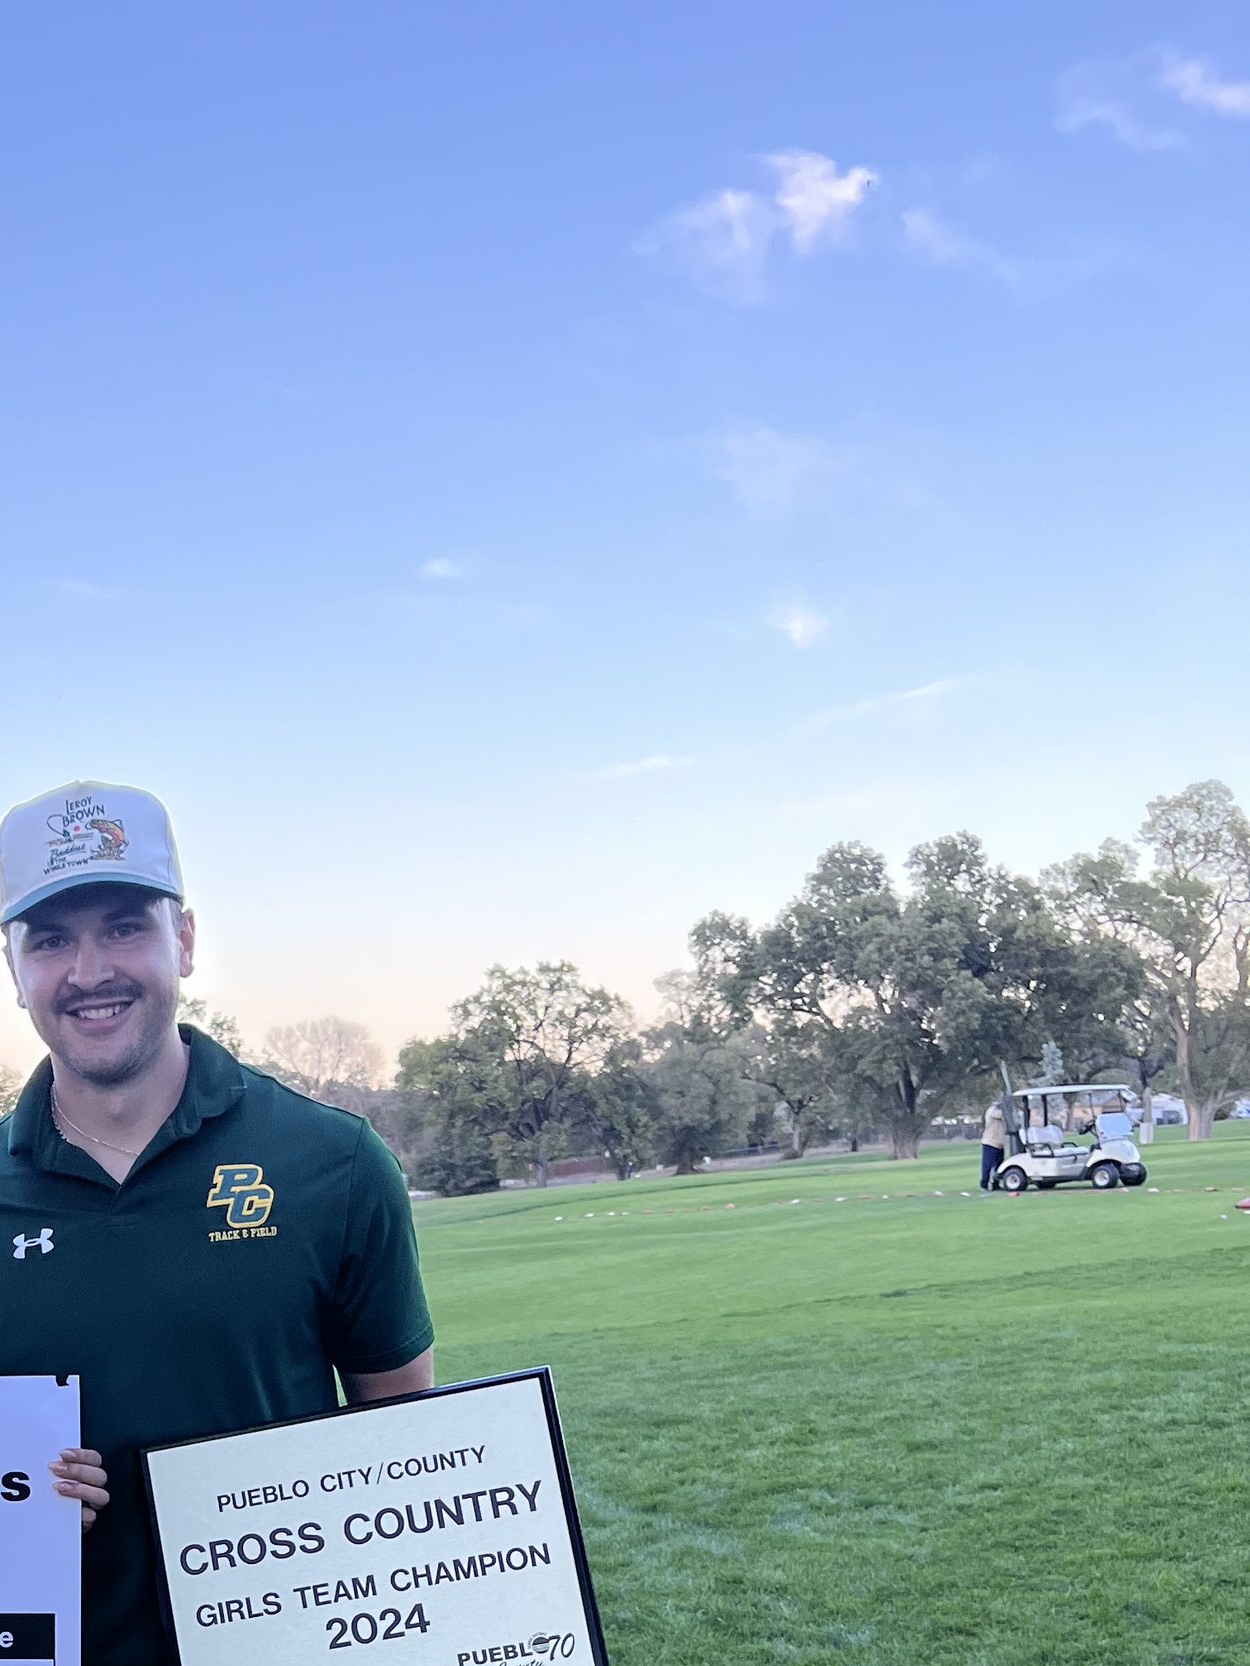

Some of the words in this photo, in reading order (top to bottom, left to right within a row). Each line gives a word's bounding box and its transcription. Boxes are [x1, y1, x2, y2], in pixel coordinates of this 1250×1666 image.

[63, 805, 105, 827] BROWN
[66, 796, 92, 815] LEROY
[208, 1229, 241, 1242] TRACK
[250, 1226, 277, 1238] FIELD
[217, 1479, 310, 1513] PUEBLO
[179, 1521, 326, 1576] CROSS
[343, 1480, 543, 1546] COUNTRY
[195, 1591, 283, 1628] GIRLS
[293, 1574, 378, 1610] TEAM
[390, 1543, 552, 1593] CHAMPION
[325, 1603, 431, 1650] 2024
[550, 1632, 575, 1661] 70
